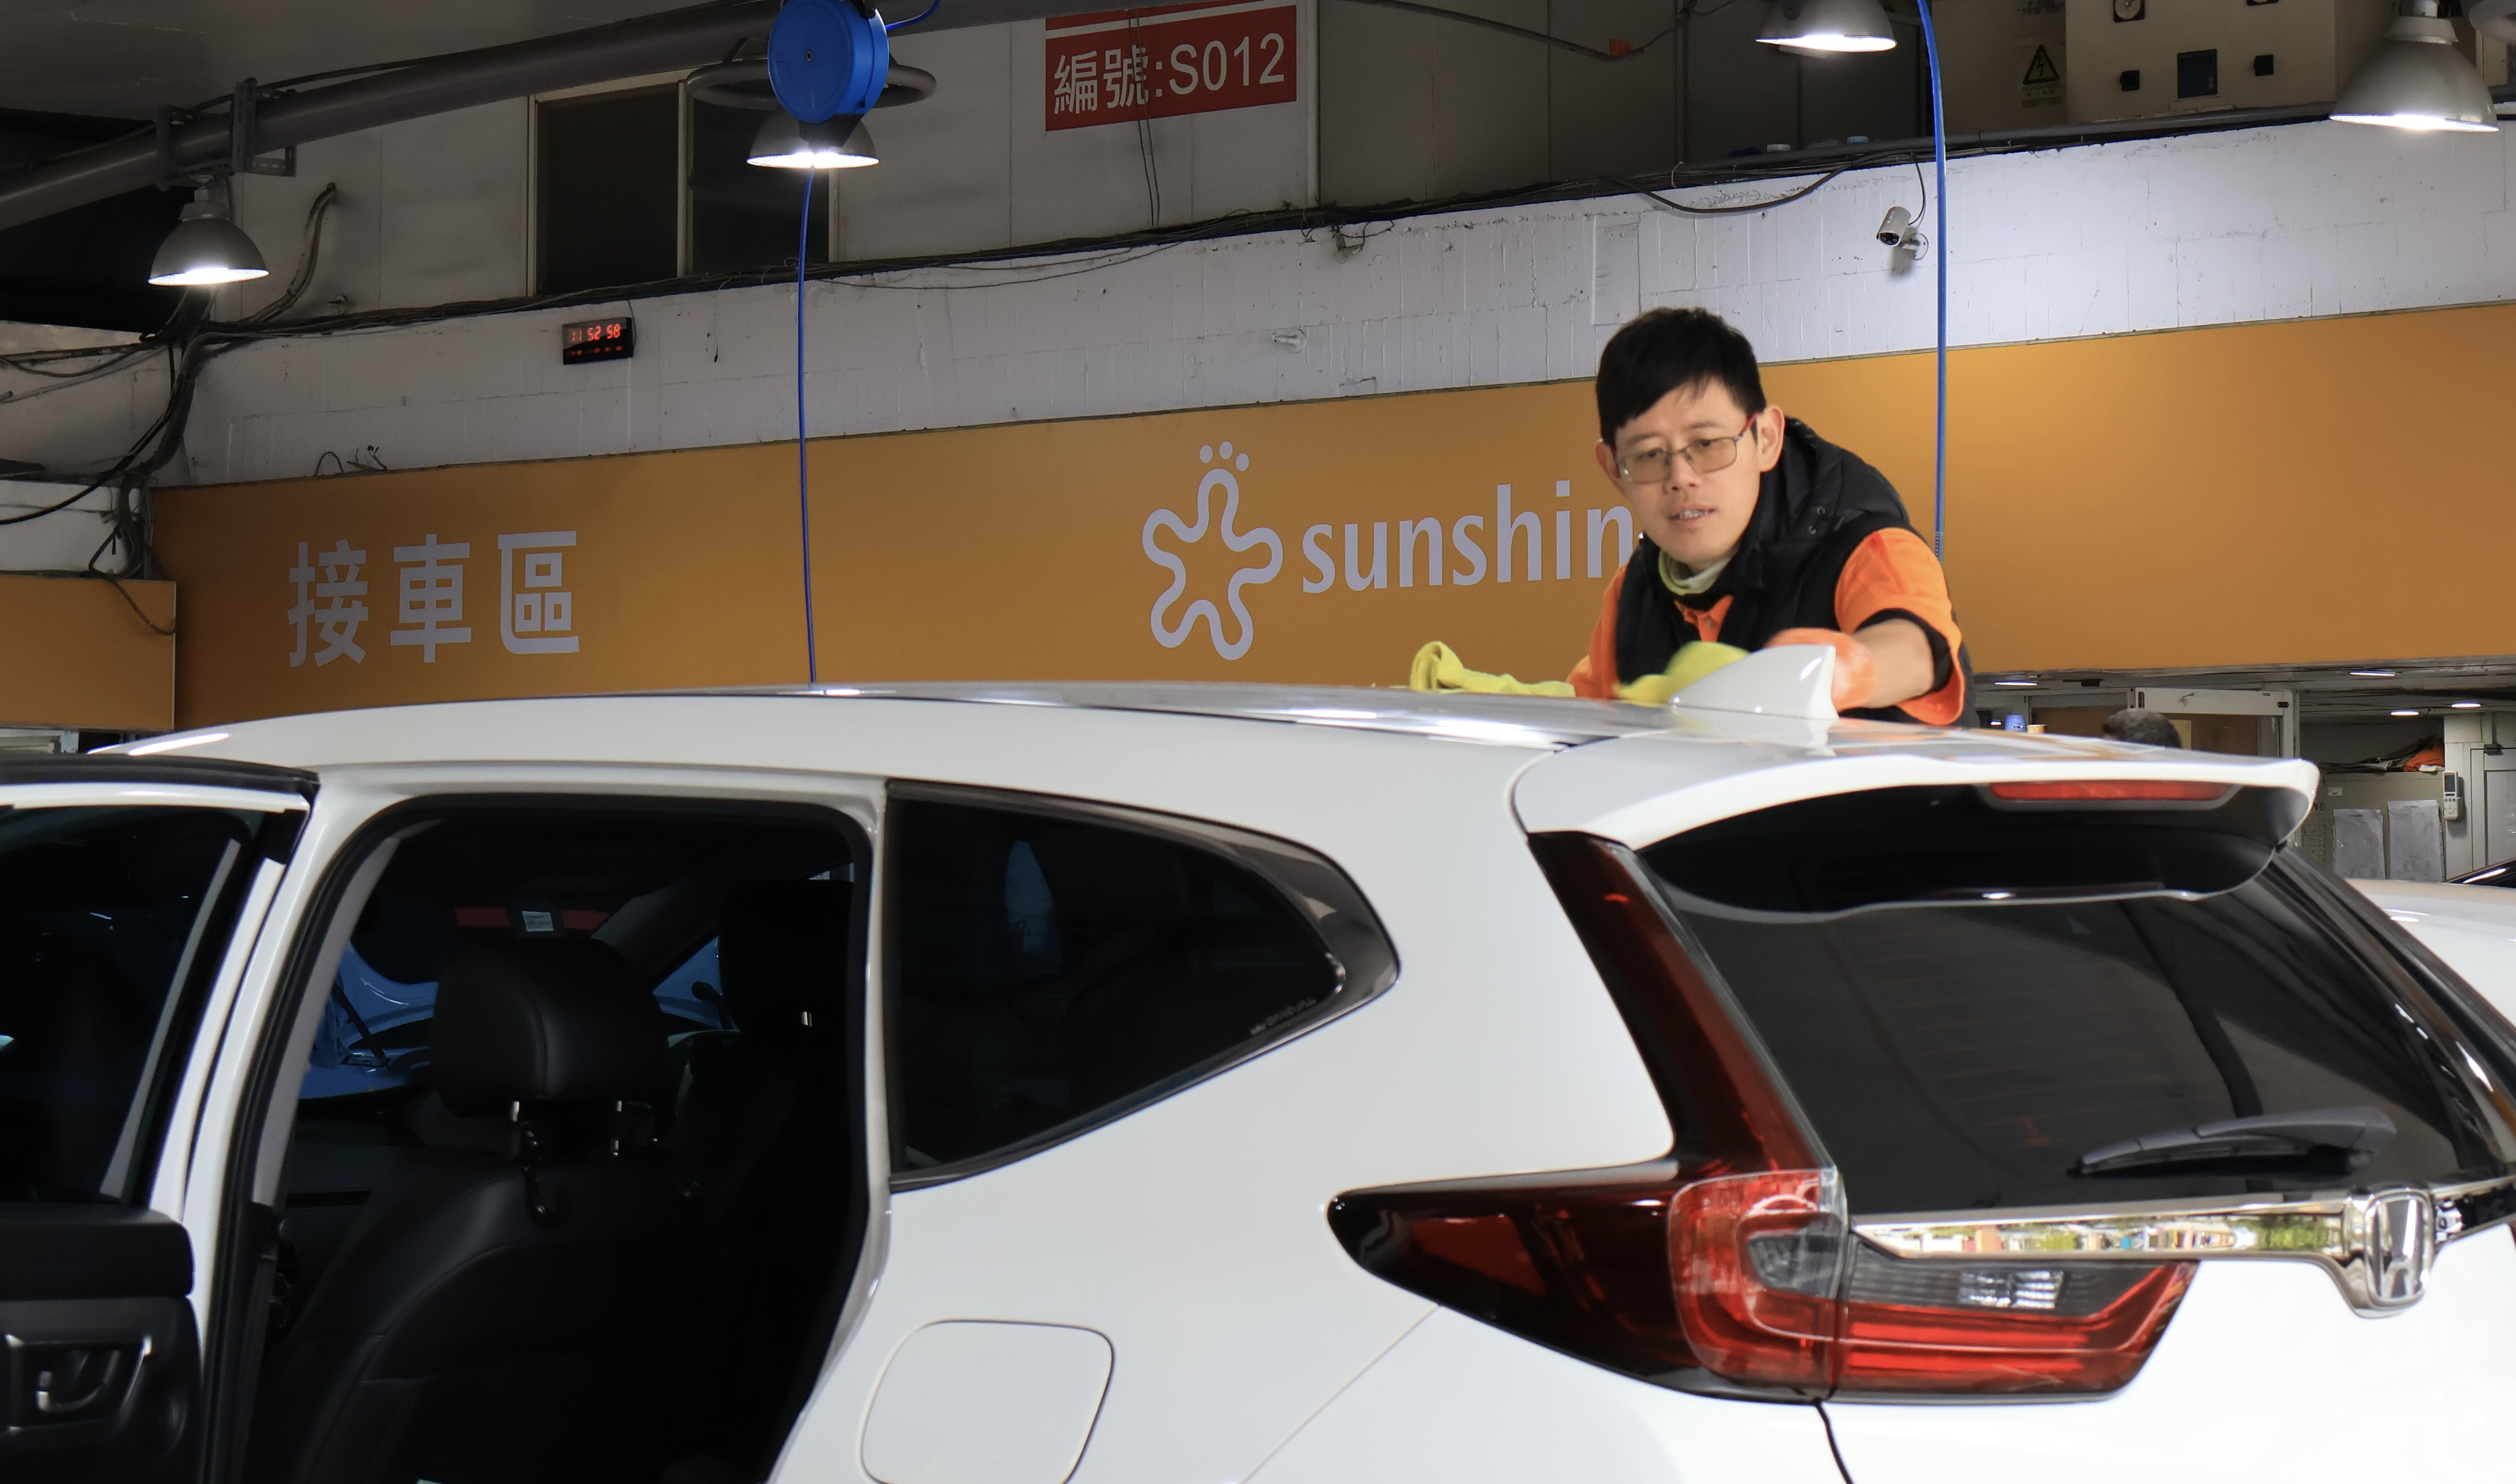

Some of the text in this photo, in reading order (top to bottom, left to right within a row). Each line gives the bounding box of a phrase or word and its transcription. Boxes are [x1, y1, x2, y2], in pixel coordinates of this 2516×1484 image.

[1054, 32, 1285, 115] 編號:S012
[587, 325, 602, 341] 52
[606, 323, 621, 340] 58
[287, 530, 580, 667] 接車區
